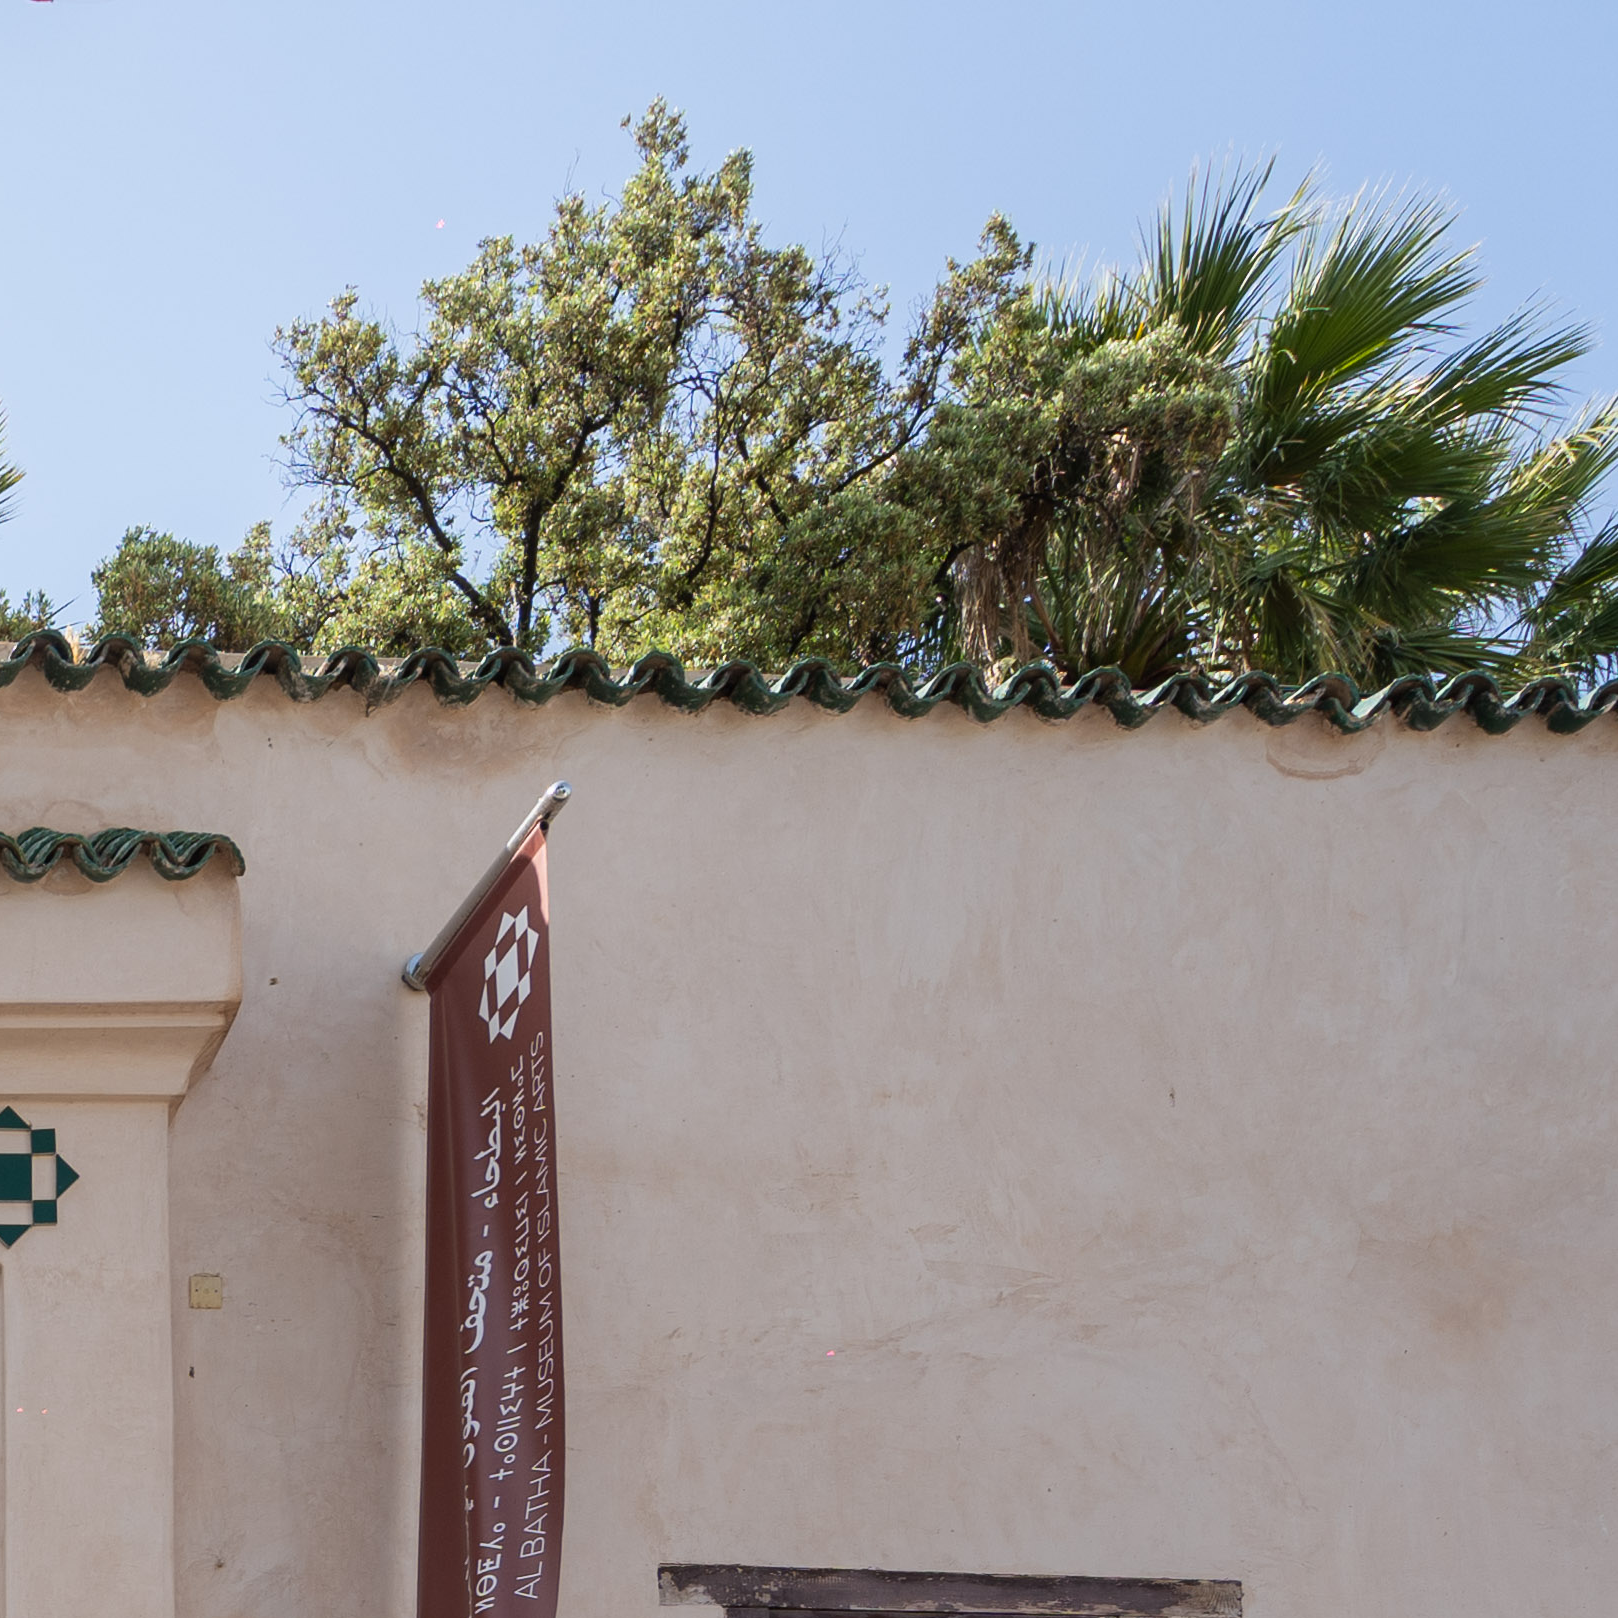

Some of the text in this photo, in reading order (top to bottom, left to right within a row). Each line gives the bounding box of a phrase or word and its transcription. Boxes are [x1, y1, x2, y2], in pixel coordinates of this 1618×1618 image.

[530, 1031, 547, 1112] ARTS
[469, 1087, 506, 1210] البطحاء
[533, 1118, 552, 1244] ISLAMIC
[459, 1250, 493, 1355] متحف
[537, 1248, 553, 1288] OF
[534, 1291, 555, 1430] MUSEUM
[519, 1449, 553, 1558] BATHA
[513, 1561, 543, 1599] AL
